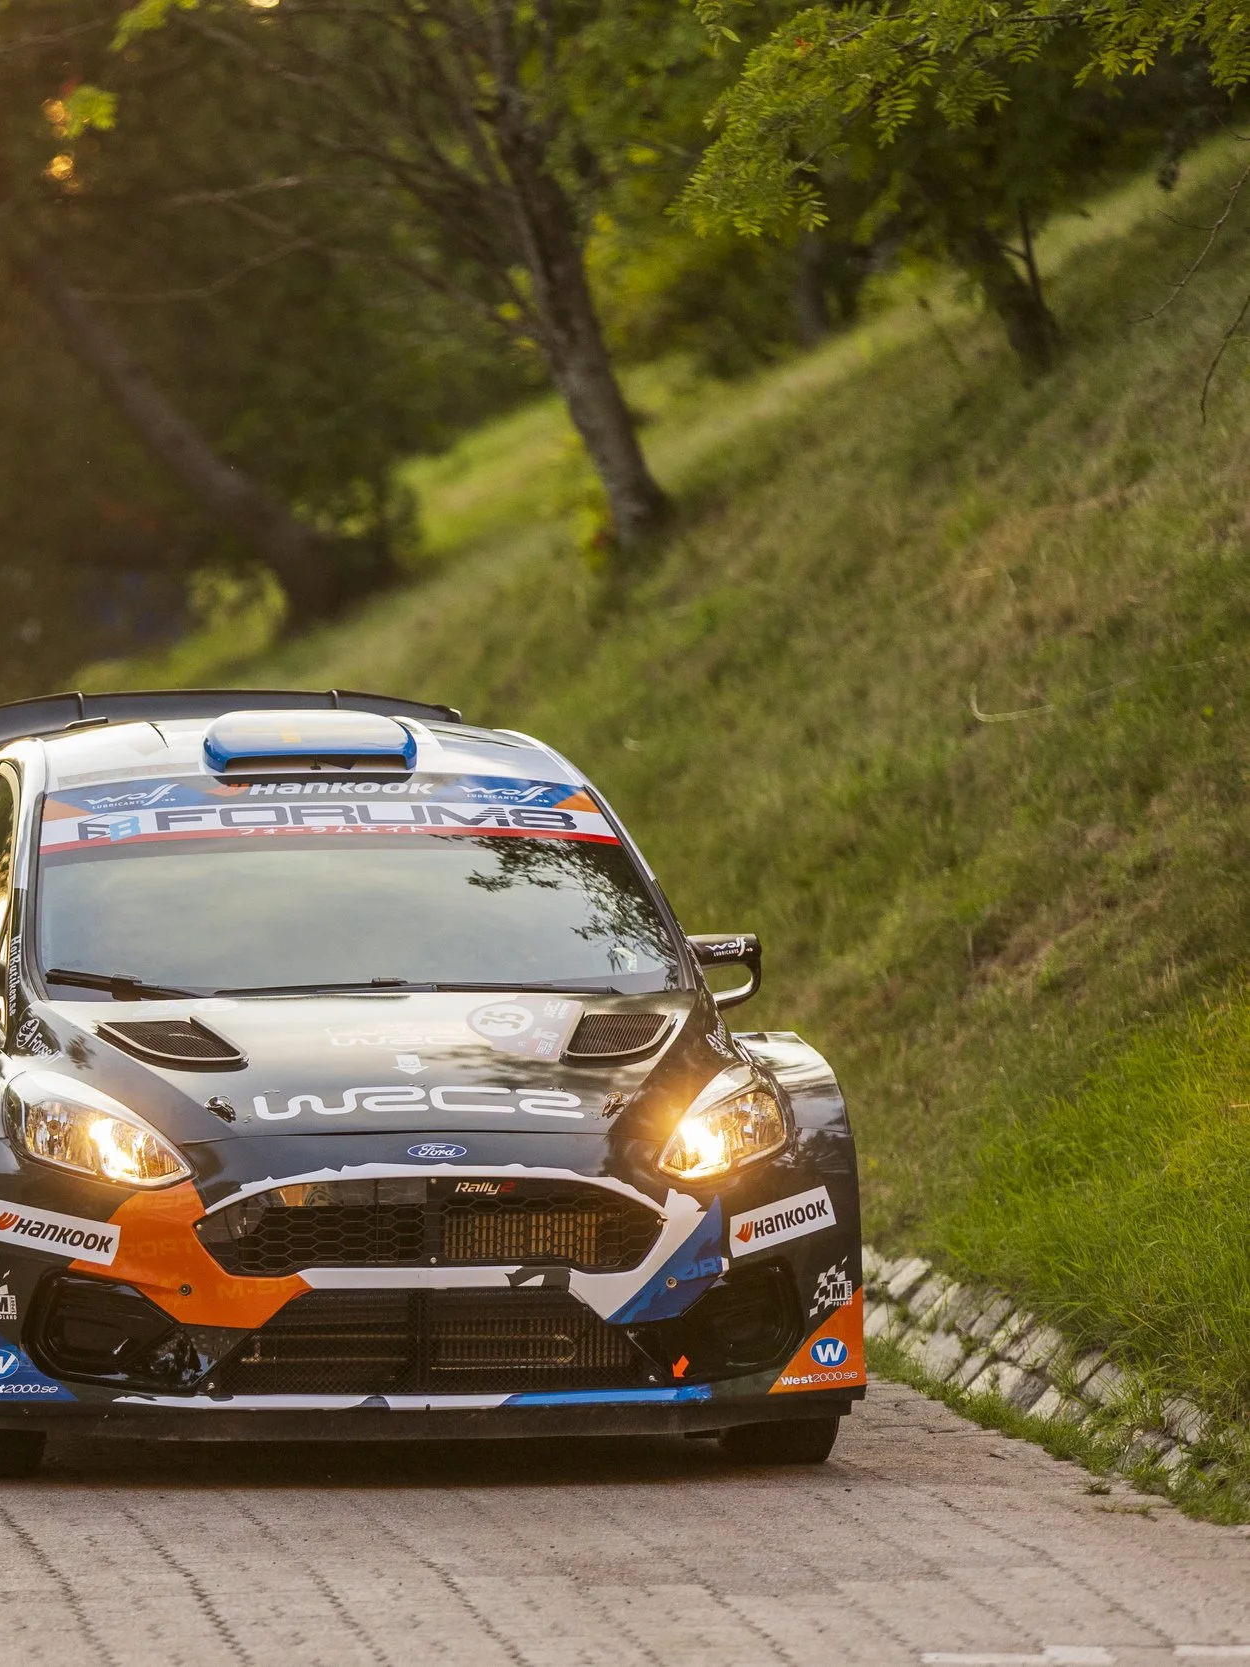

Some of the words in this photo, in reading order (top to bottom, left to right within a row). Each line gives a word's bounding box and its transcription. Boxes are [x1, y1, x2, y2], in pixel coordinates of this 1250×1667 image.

[92, 799, 145, 810] LUBRICANTS
[467, 793, 519, 802] LUBRICANTS
[155, 804, 577, 831] FORUM8
[238, 825, 425, 836] フォーラムエイト
[479, 1010, 526, 1030] 35
[253, 1086, 585, 1120] WRC2
[417, 1144, 457, 1158] Ford
[455, 1181, 517, 1195] Rally2
[831, 1282, 846, 1300] M
[815, 1339, 845, 1363] W
[781, 1371, 858, 1386] West2000.se
